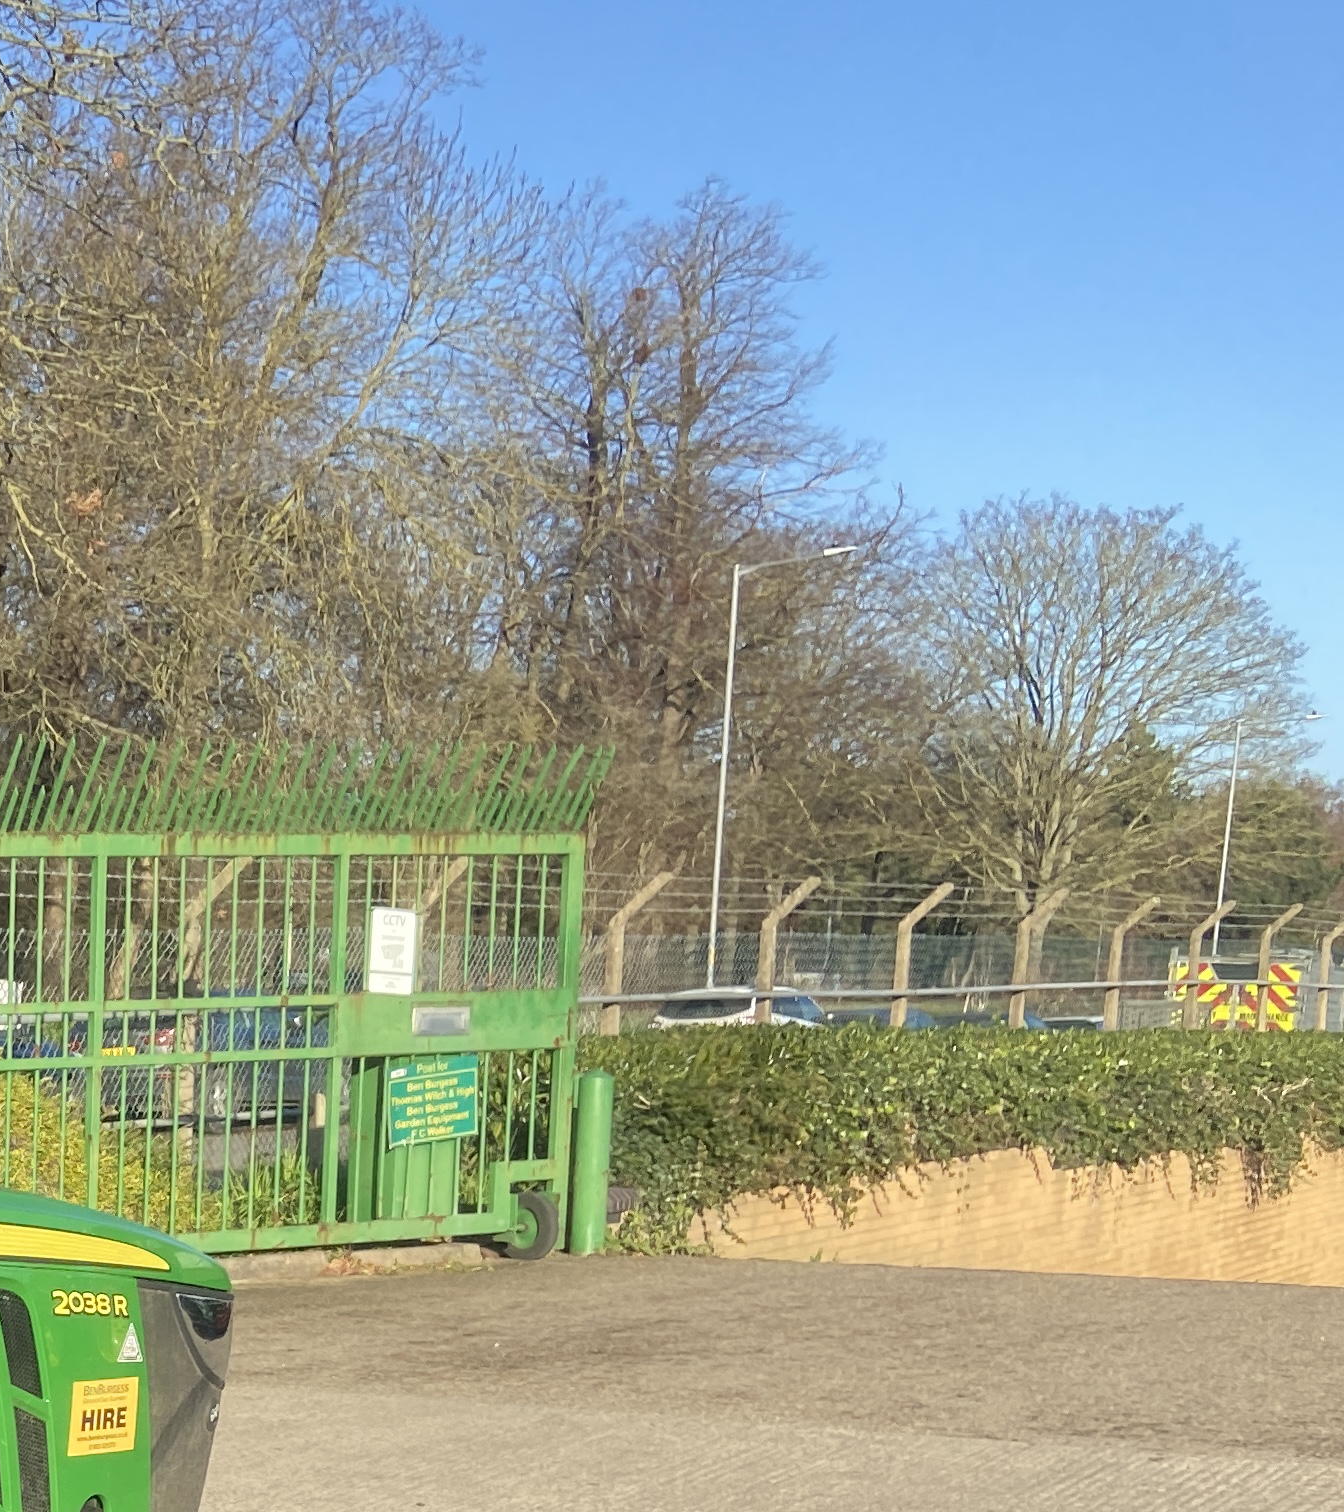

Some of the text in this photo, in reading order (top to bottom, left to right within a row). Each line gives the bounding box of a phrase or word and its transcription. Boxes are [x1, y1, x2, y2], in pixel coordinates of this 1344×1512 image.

[383, 914, 407, 927] CCTV
[407, 1077, 459, 1092] Ben Burgess
[391, 1095, 423, 1106] Thomas
[406, 1101, 459, 1116] Ben Burgess
[394, 1110, 470, 1129] Garden Equipment
[80, 1406, 127, 1431] HIRE
